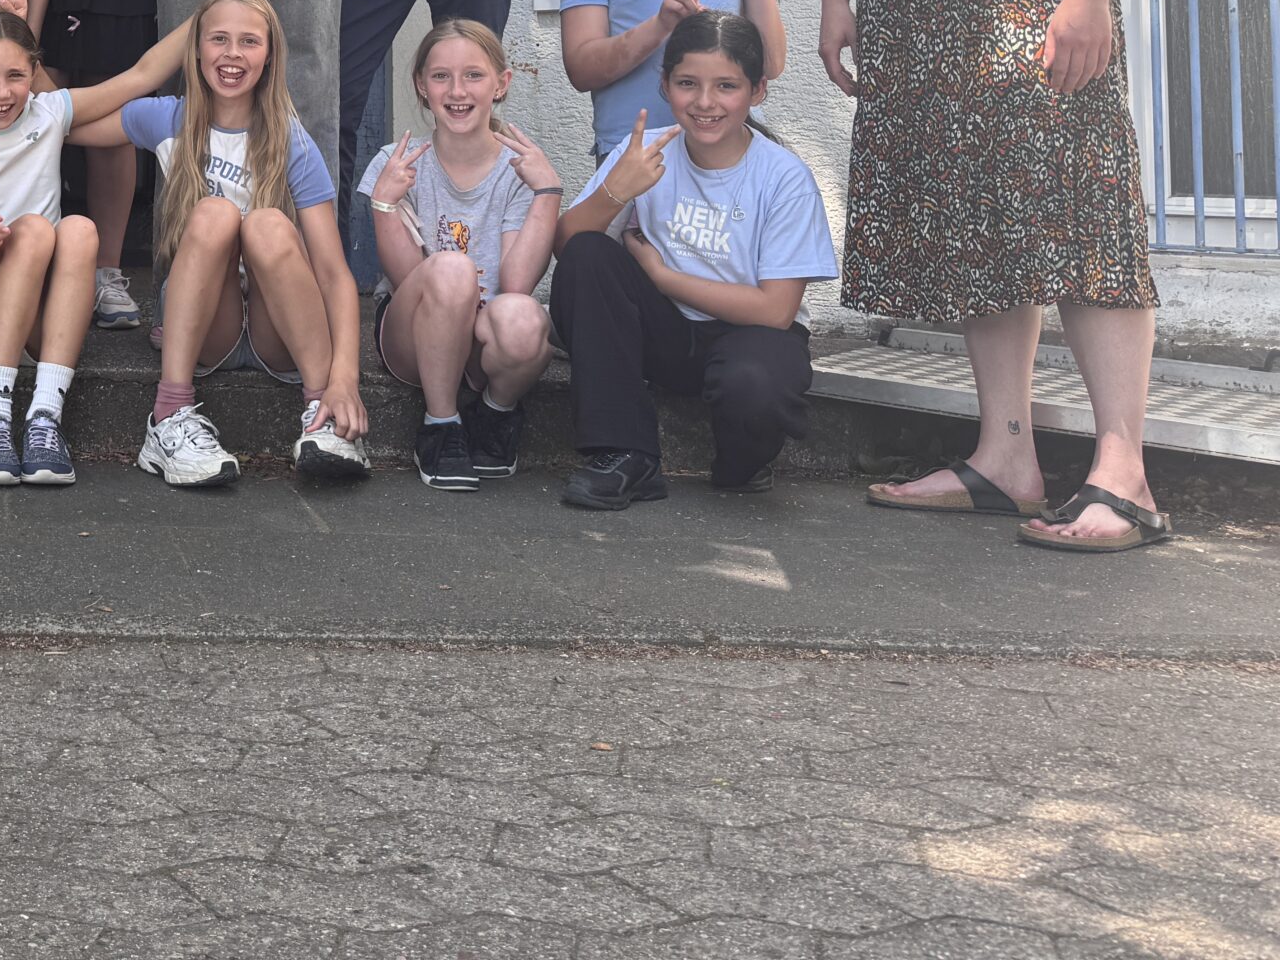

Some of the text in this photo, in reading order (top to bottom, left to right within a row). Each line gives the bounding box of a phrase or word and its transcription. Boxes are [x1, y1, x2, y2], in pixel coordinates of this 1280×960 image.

[681, 195, 695, 204] THE
[674, 202, 727, 231] NEW
[666, 220, 731, 253] YORK
[666, 241, 687, 250] SOHO
